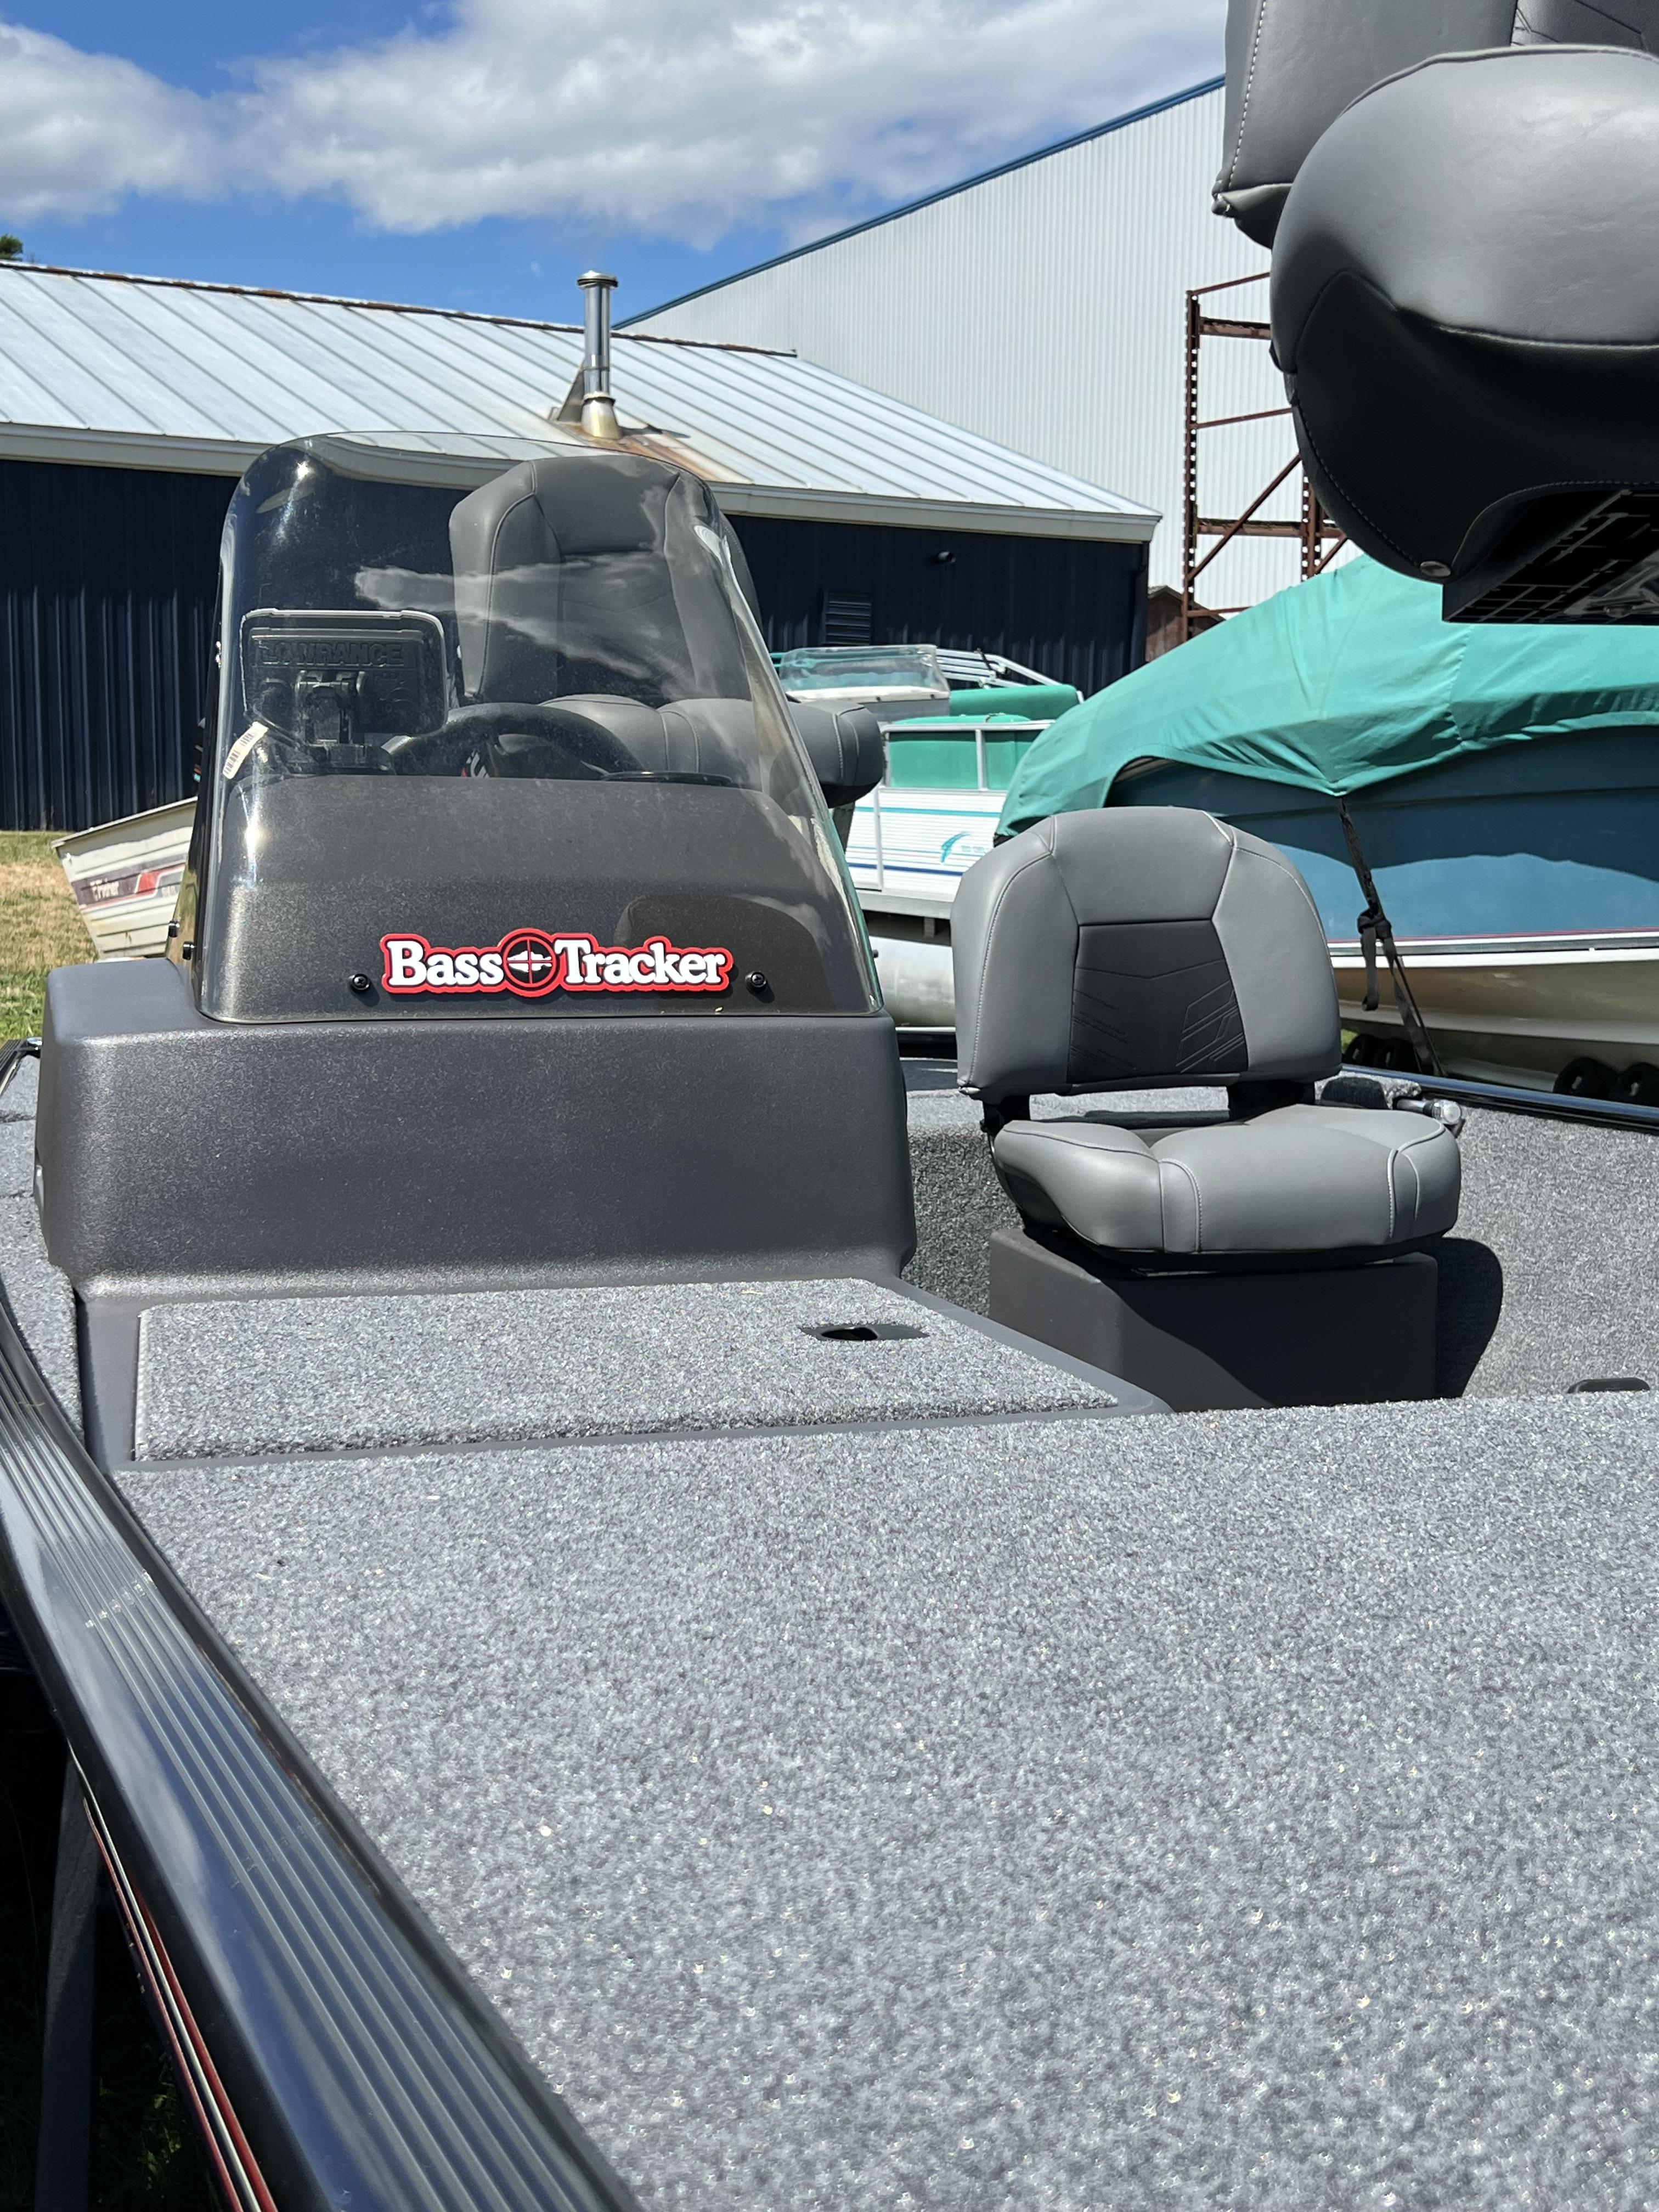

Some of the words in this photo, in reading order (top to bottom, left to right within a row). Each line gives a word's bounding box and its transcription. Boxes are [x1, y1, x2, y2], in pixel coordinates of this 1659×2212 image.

[262, 641, 404, 667] LOWRANCE
[386, 940, 505, 985] Bass
[554, 939, 726, 984] Tracker
